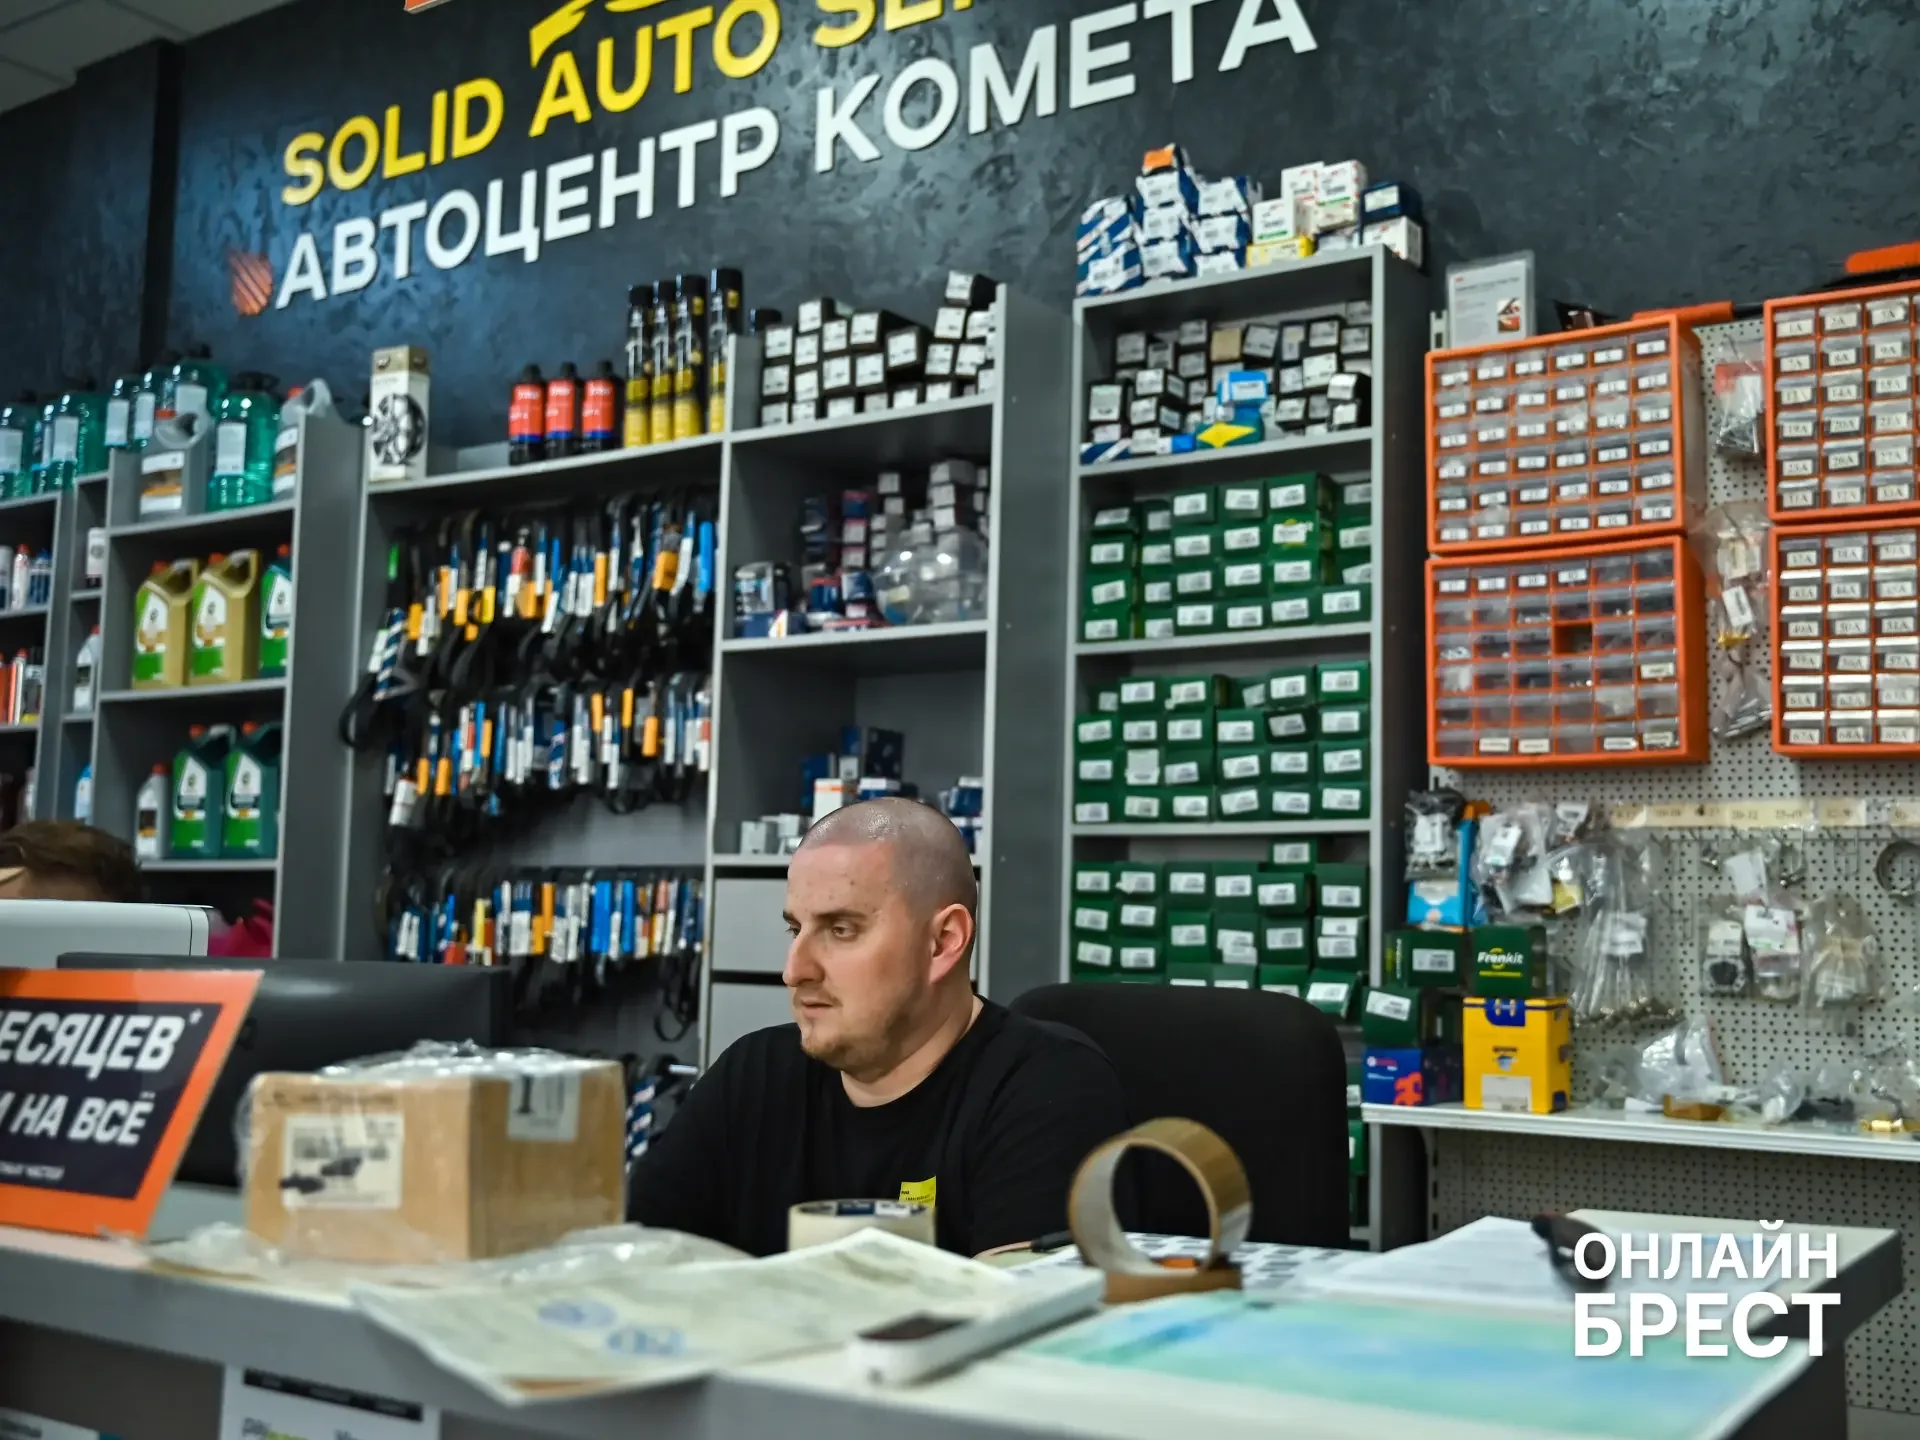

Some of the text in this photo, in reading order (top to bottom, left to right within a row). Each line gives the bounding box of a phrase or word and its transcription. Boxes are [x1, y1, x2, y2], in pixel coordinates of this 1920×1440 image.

[276, 0, 1318, 310] АВТОЦЕНТР КОМЕТА
[282, 0, 780, 206] SOLID AUTO
[0, 1009, 203, 1081] ЕСЯЦЕВ
[9, 1093, 69, 1139] НА
[67, 1091, 156, 1146] ВСЁ
